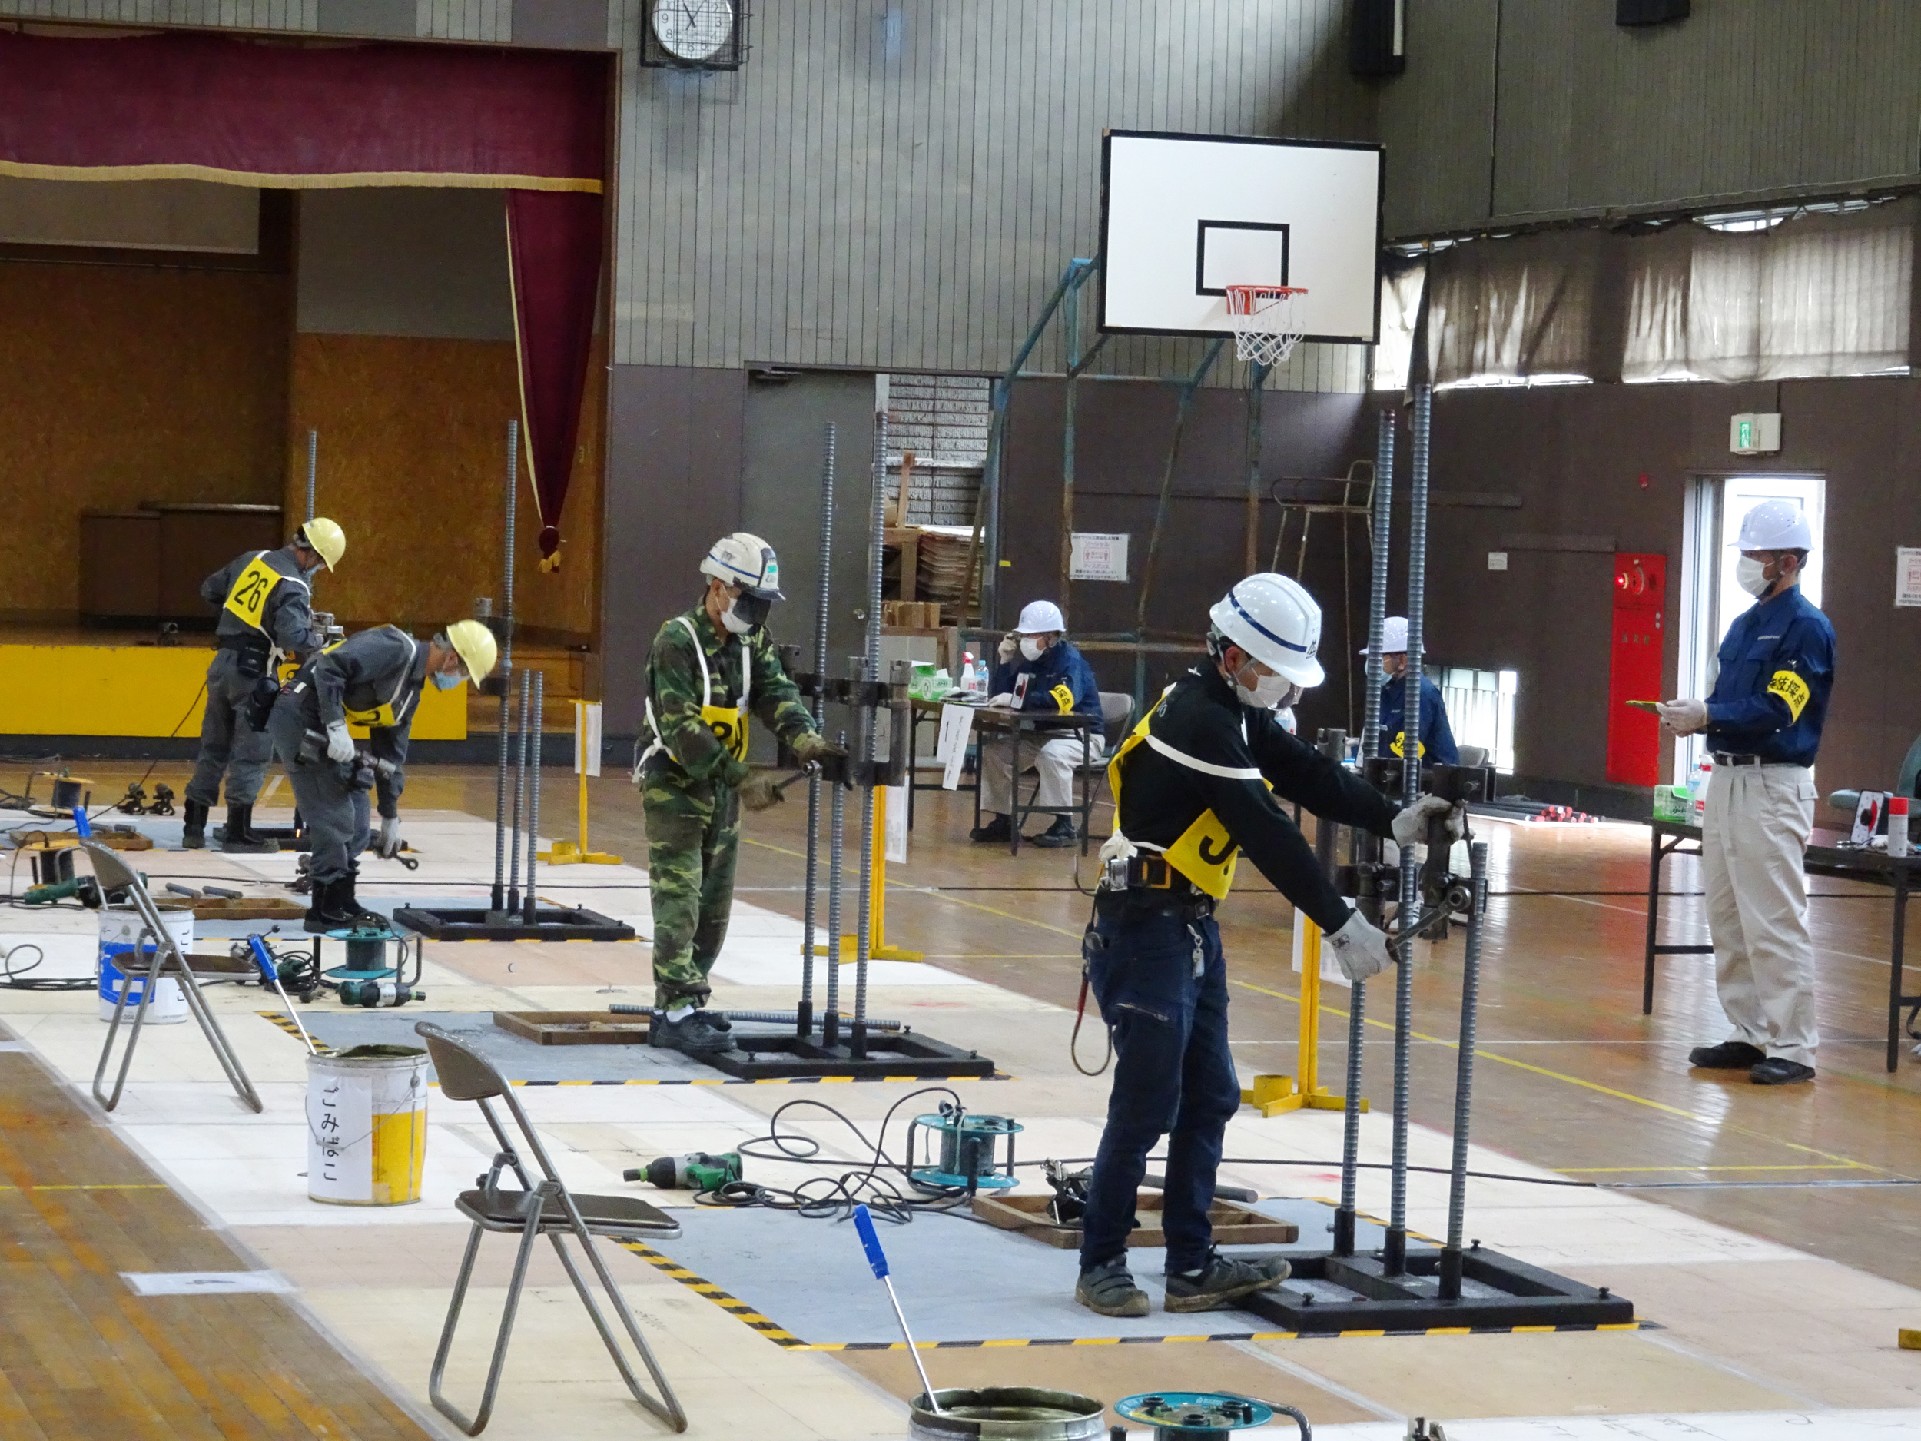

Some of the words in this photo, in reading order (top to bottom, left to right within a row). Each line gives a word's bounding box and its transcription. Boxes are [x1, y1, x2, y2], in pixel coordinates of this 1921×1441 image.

[661, 13, 669, 23] 9
[233, 570, 269, 614] 26
[321, 1086, 340, 1181] ごみばこ
